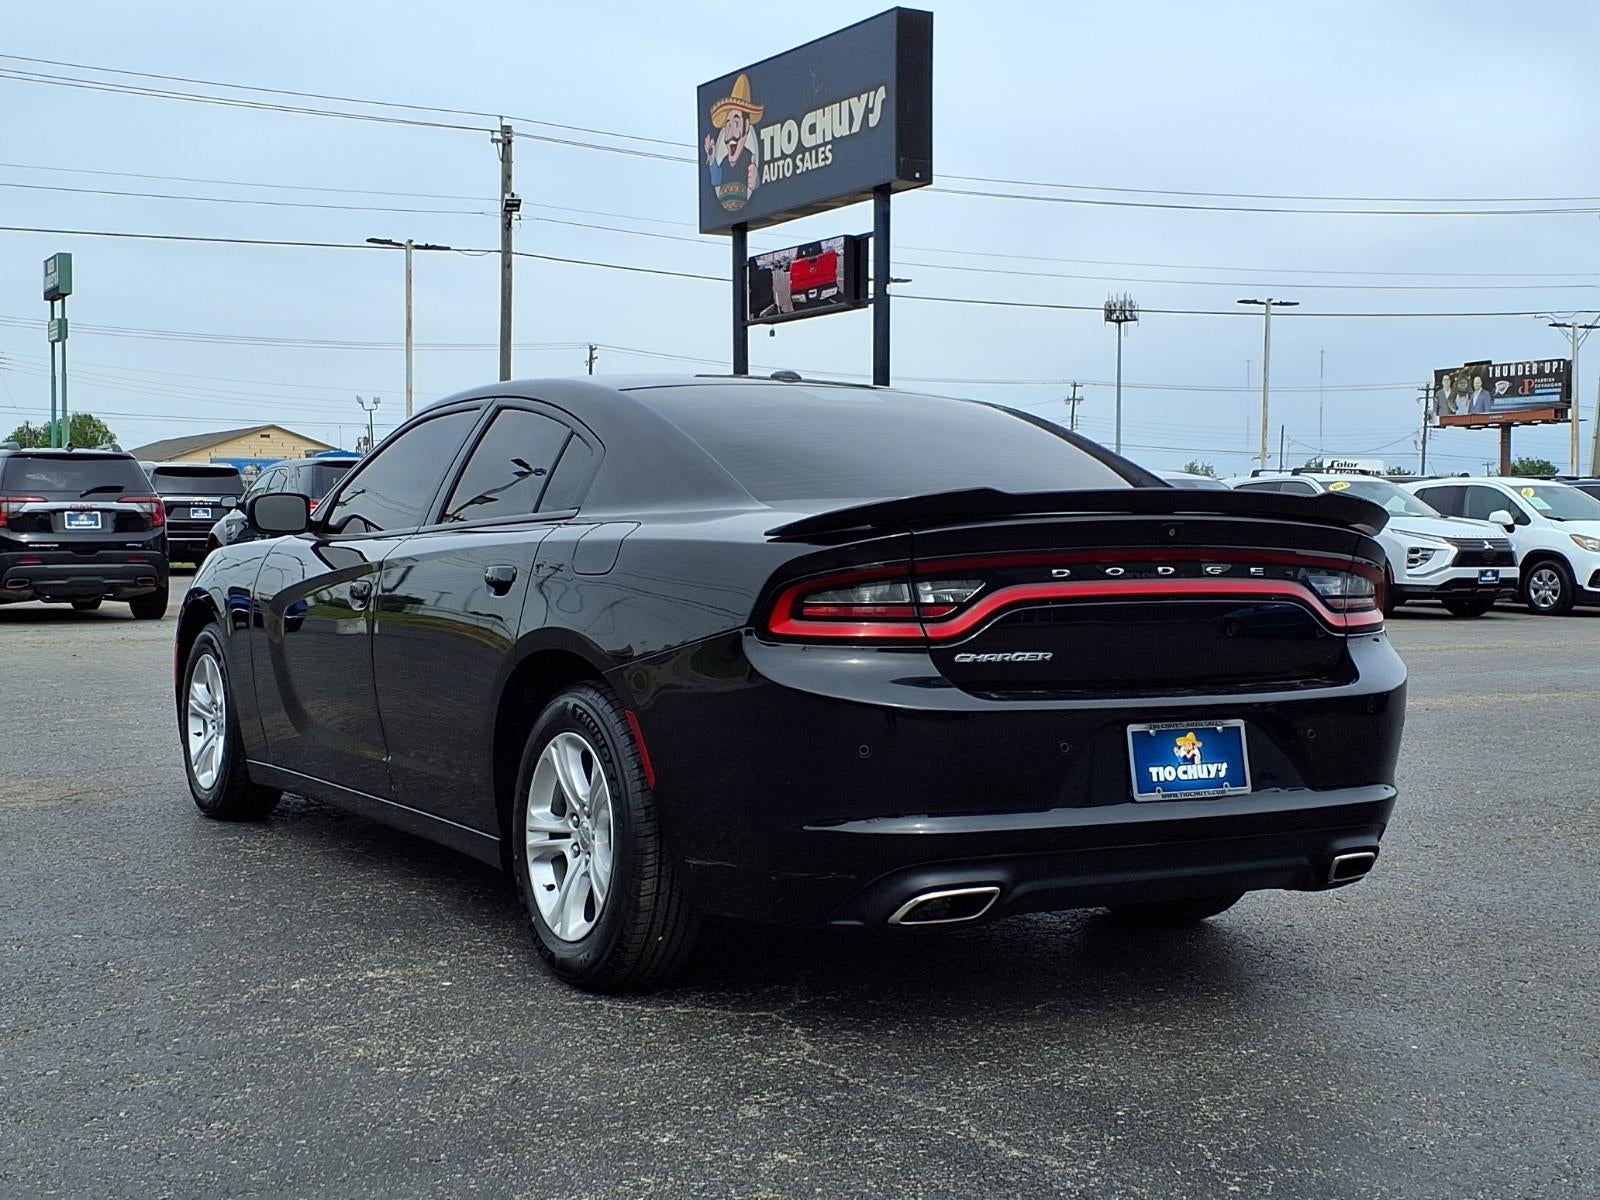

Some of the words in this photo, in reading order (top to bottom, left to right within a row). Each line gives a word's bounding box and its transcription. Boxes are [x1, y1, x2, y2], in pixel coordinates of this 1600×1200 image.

[761, 120, 799, 161] TIO
[800, 86, 886, 148] CHUY'S
[762, 160, 793, 184] AUTO
[797, 144, 832, 174] SALES
[1488, 363, 1538, 378] THUNDER
[1544, 361, 1564, 374] UP!
[1051, 565, 1265, 578] DODGE
[954, 652, 1053, 663] CHARGER
[1149, 765, 1176, 782] TIO
[1177, 762, 1228, 780] CHUY'S
